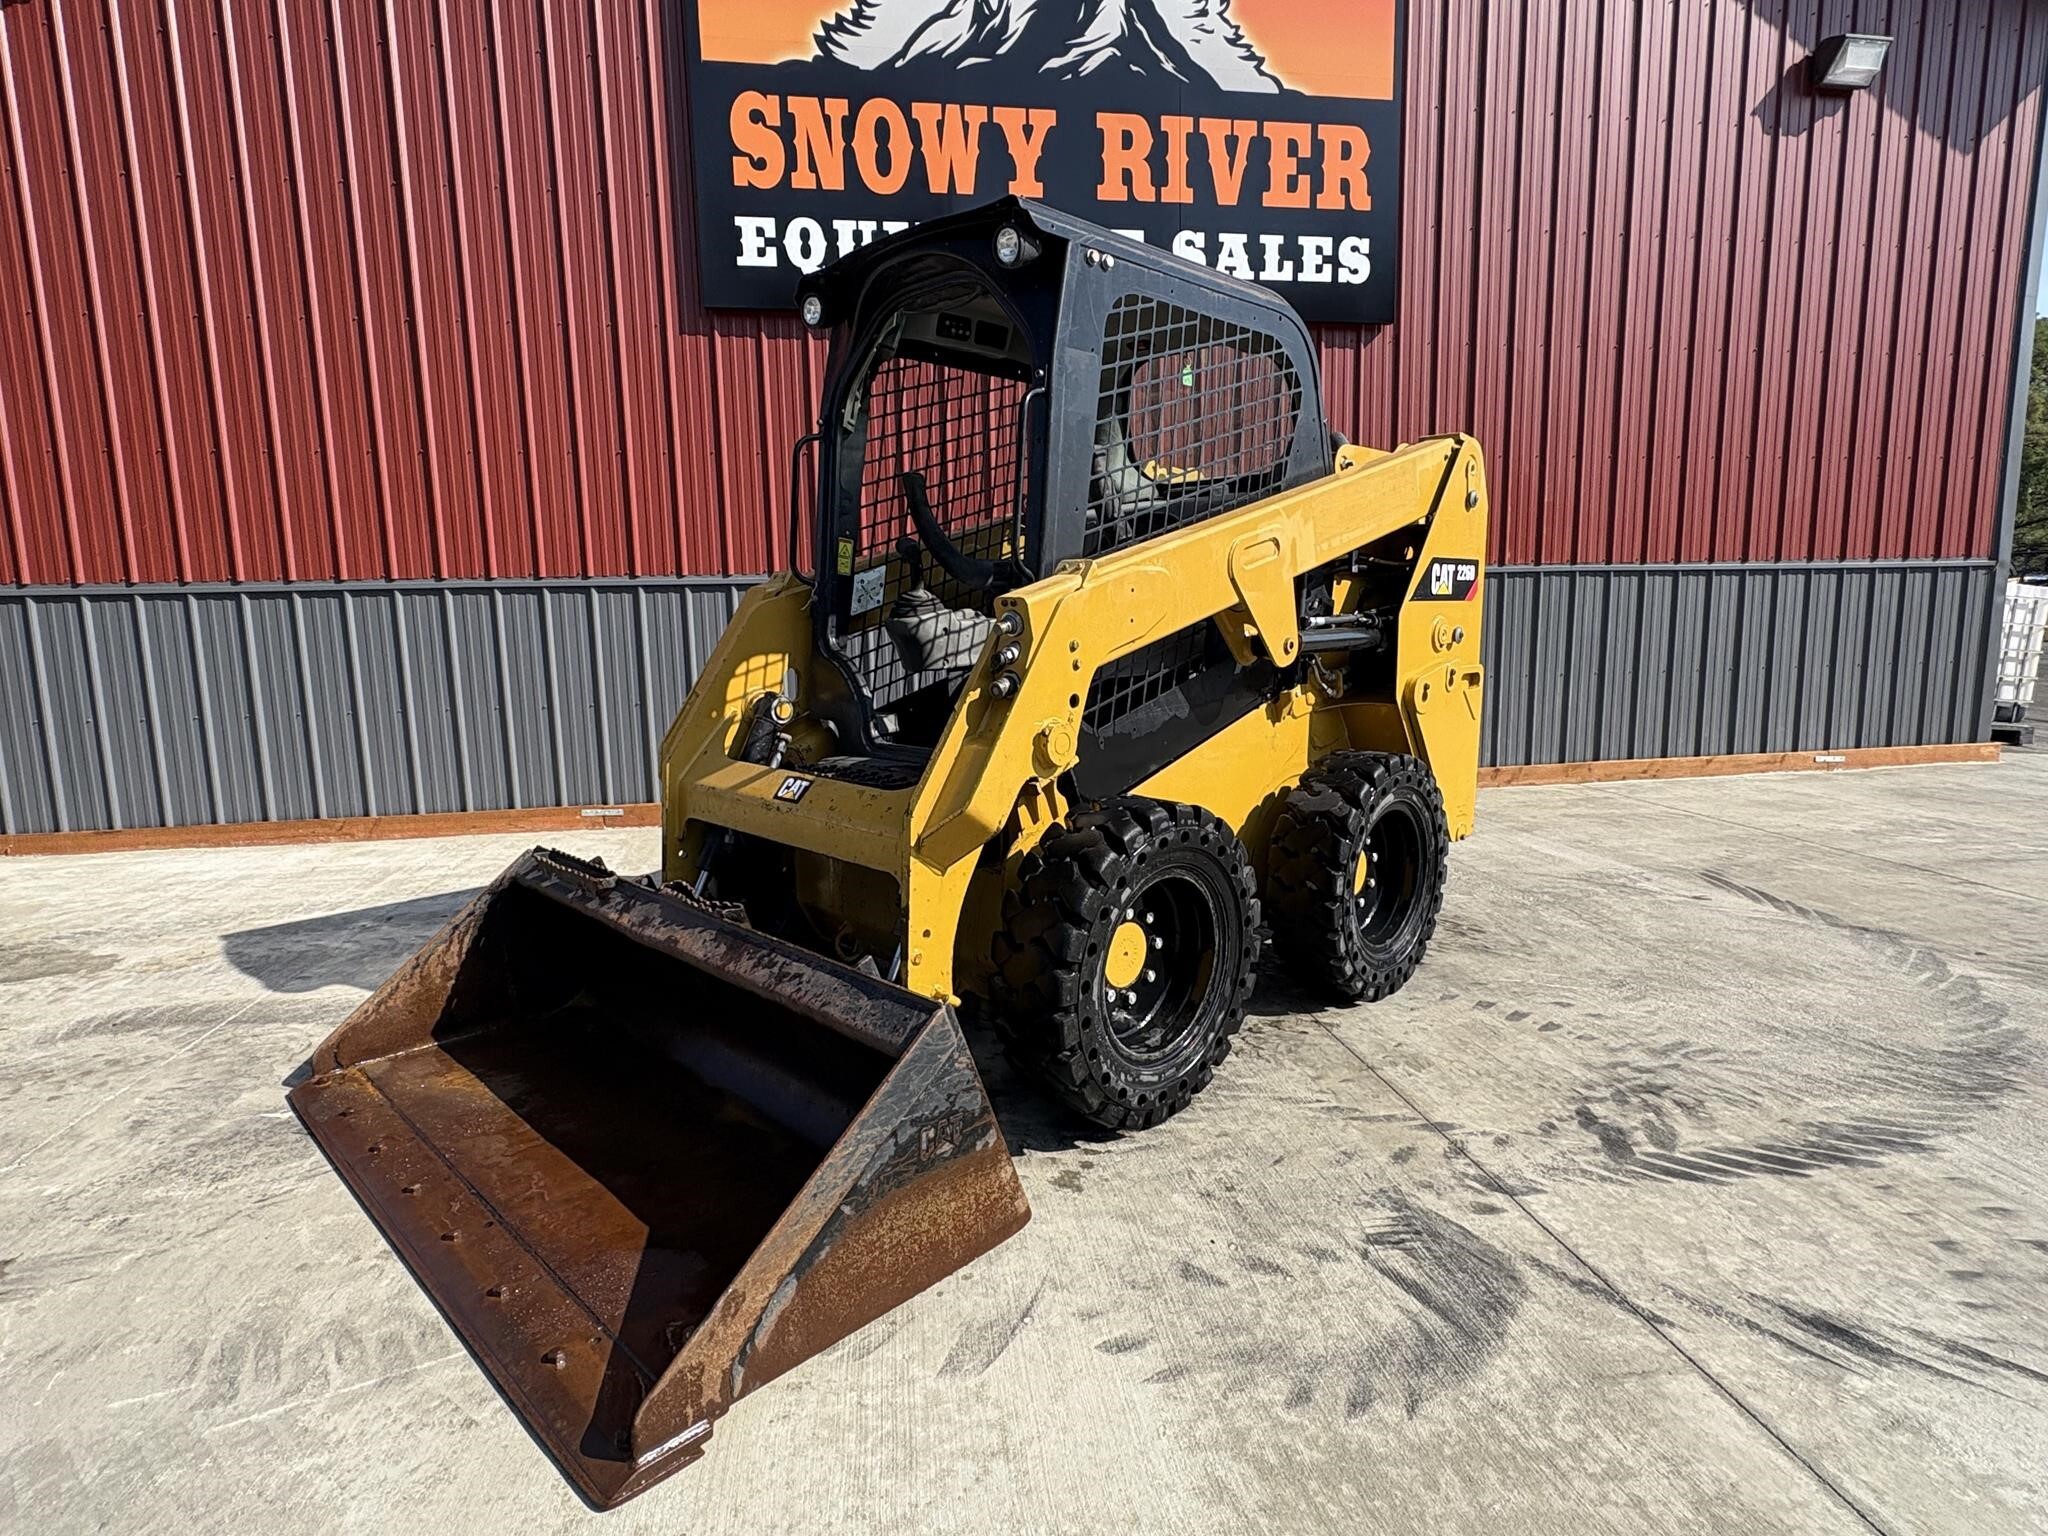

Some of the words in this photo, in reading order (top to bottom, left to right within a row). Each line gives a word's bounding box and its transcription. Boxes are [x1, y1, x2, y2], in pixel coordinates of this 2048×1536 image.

[729, 90, 1056, 197] SNOWY
[1096, 112, 1371, 210] RIVER
[1172, 229, 1371, 284] SALES
[1431, 563, 1455, 595] CAT
[777, 777, 811, 801] CAT
